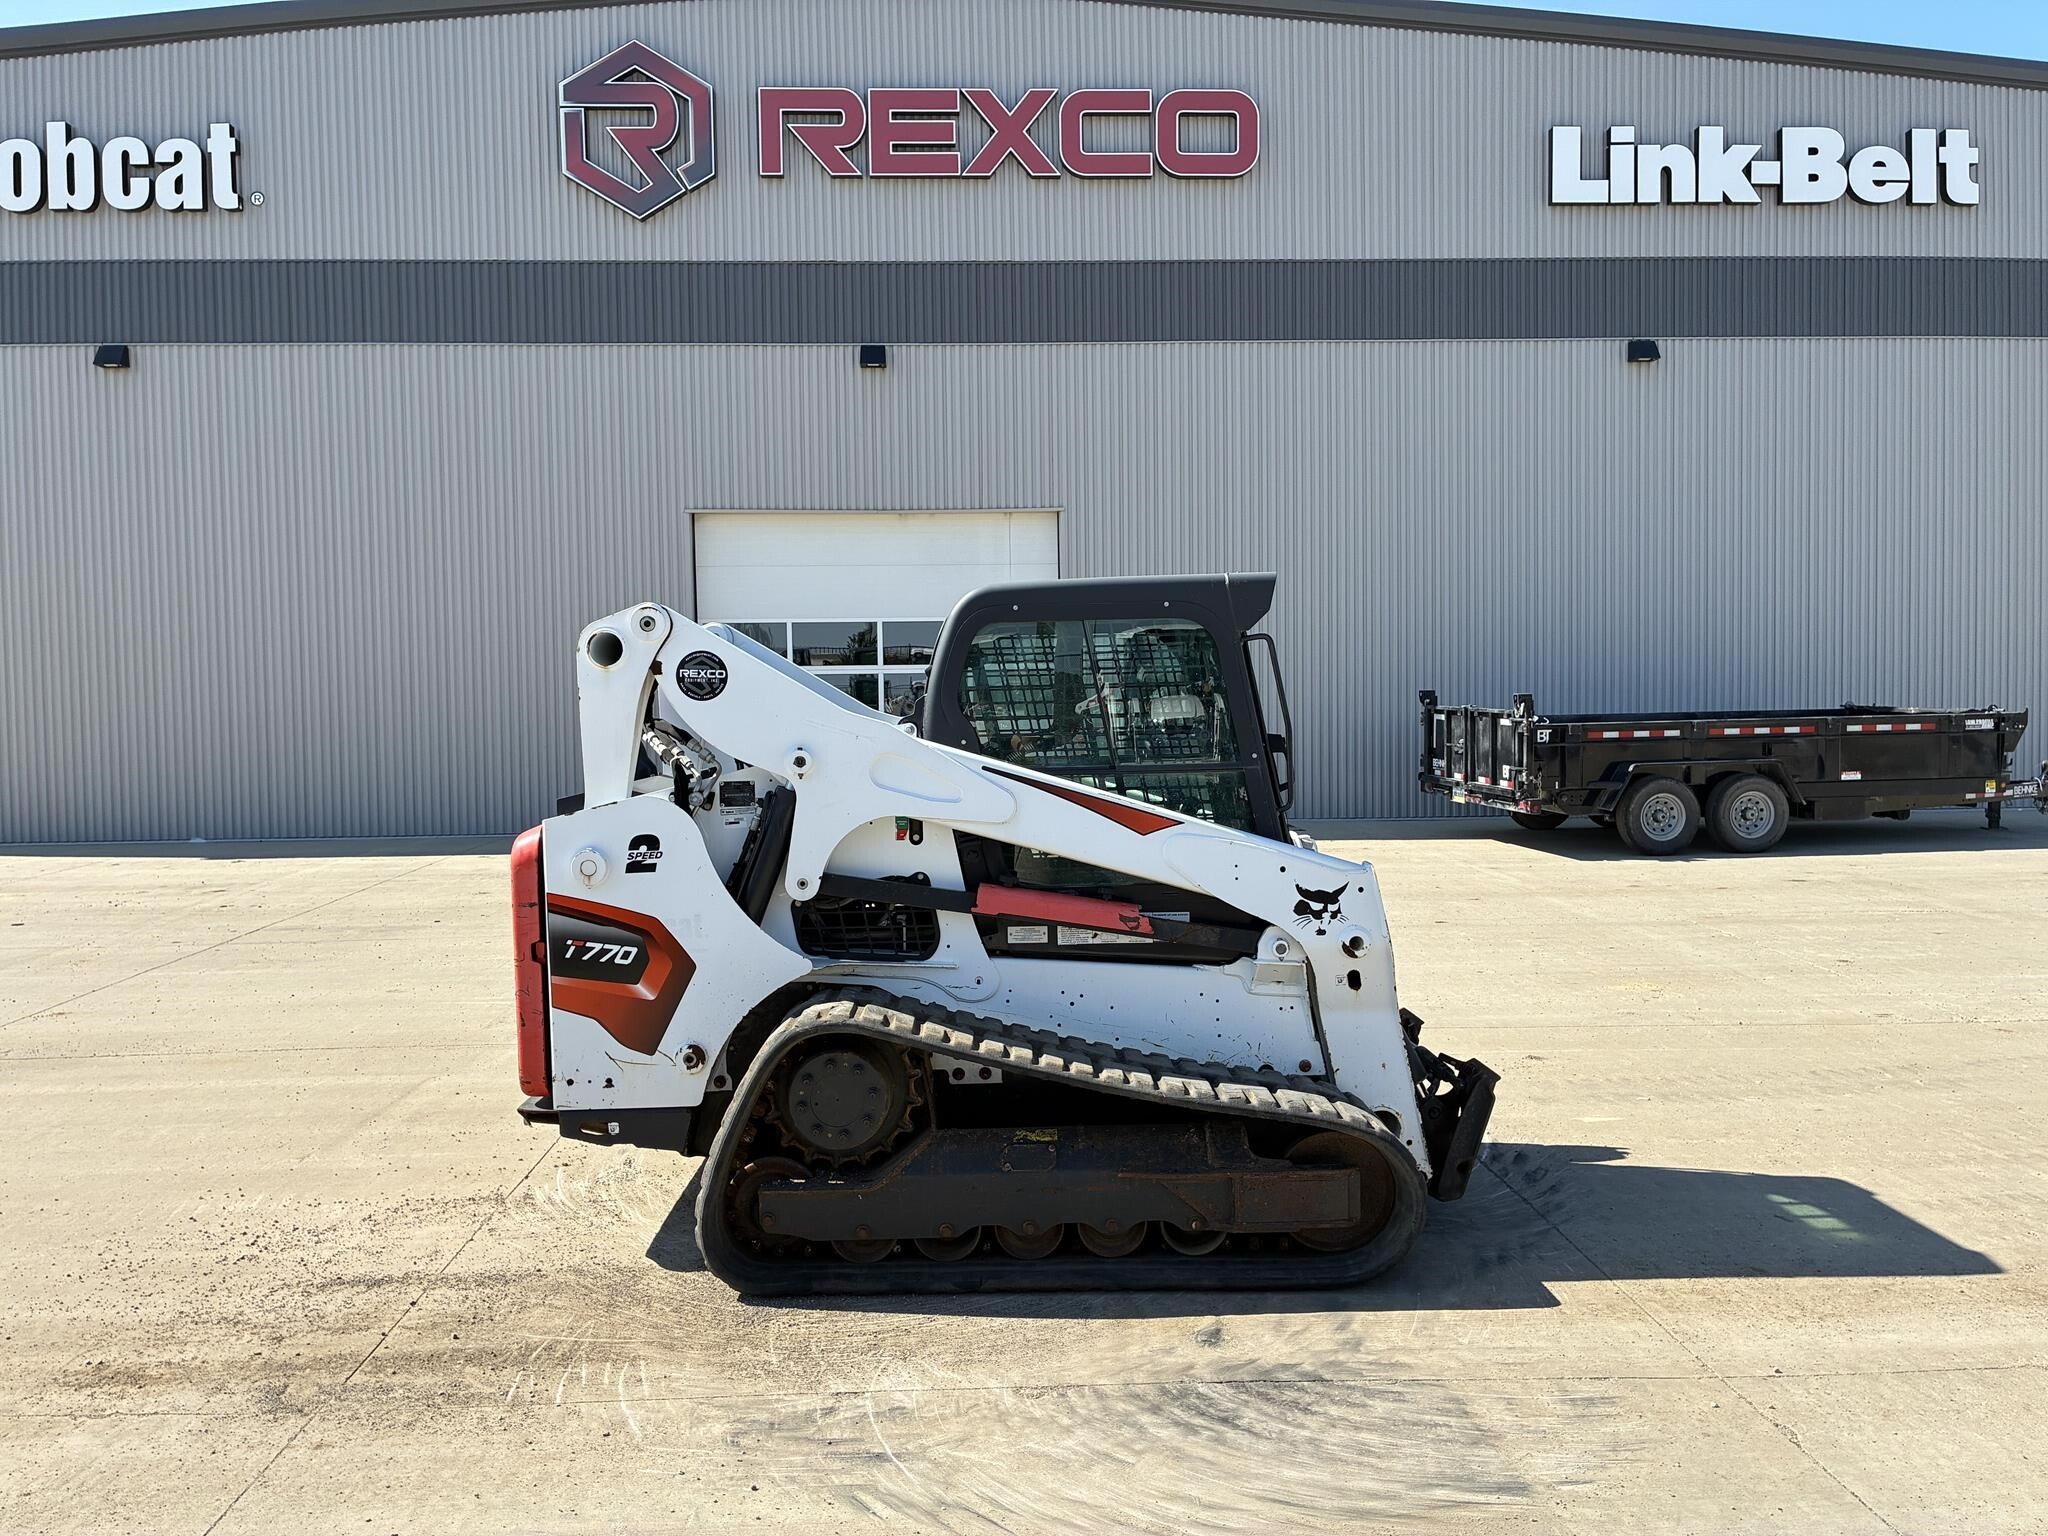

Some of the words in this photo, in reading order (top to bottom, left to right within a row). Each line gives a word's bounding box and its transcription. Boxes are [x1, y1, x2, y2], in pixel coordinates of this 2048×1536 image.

[757, 86, 1261, 178] REXCO
[1550, 125, 1979, 205] Link-Belt
[679, 669, 726, 678] REXCO
[1537, 729, 1552, 744] BT
[2013, 784, 2038, 795] BEHNKE
[625, 834, 660, 873] 2
[627, 851, 663, 860] SPEED
[564, 939, 639, 965] T770
